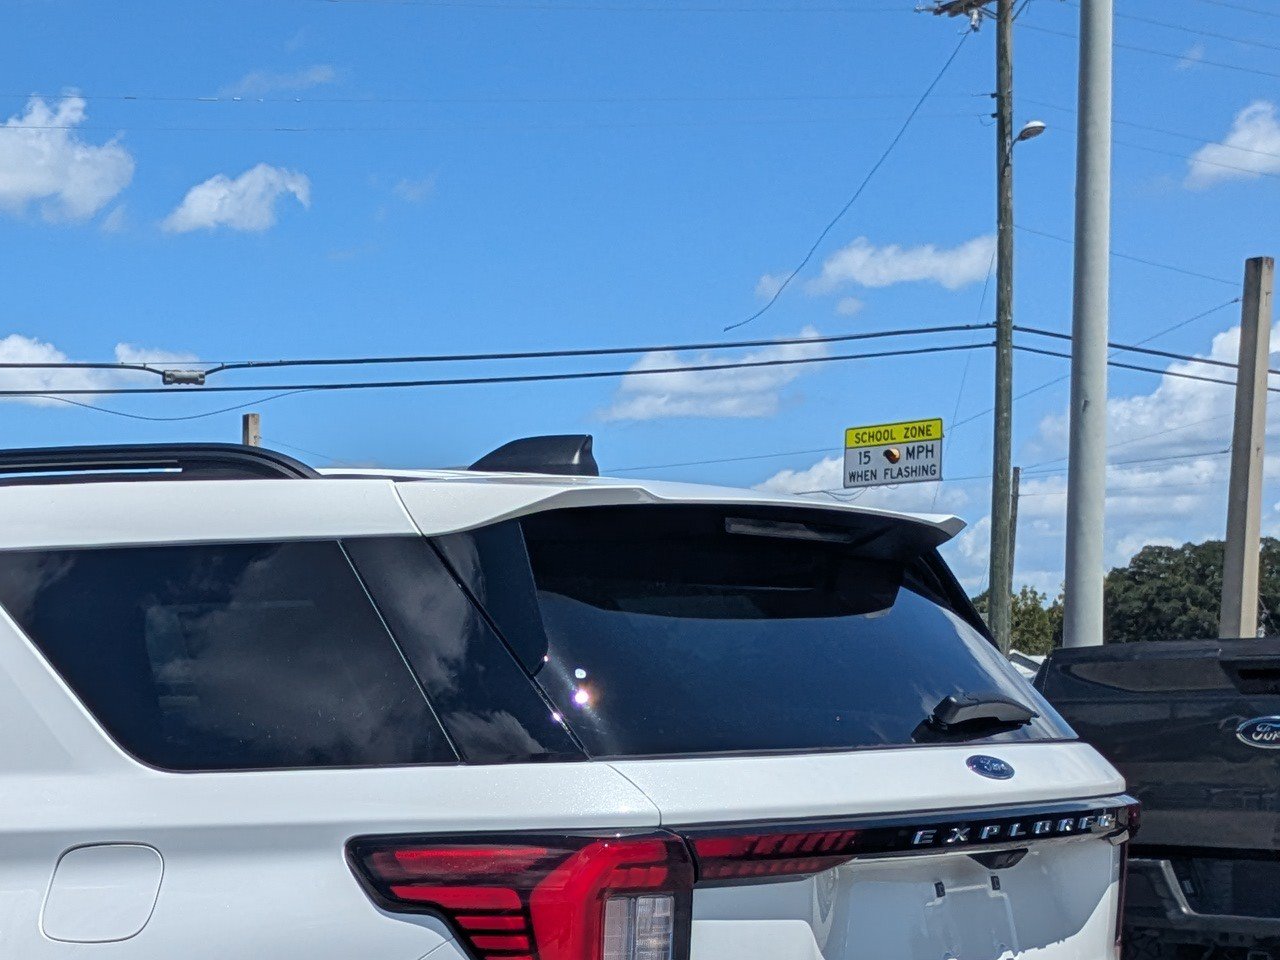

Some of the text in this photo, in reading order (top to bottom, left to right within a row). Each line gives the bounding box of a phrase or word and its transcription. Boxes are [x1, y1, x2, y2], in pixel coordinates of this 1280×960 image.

[854, 424, 933, 444] SCHOOL ZONE
[858, 444, 934, 465] 15 MPH
[848, 464, 937, 483] WHEN FLASHING
[911, 812, 1117, 845] EXPLORER
